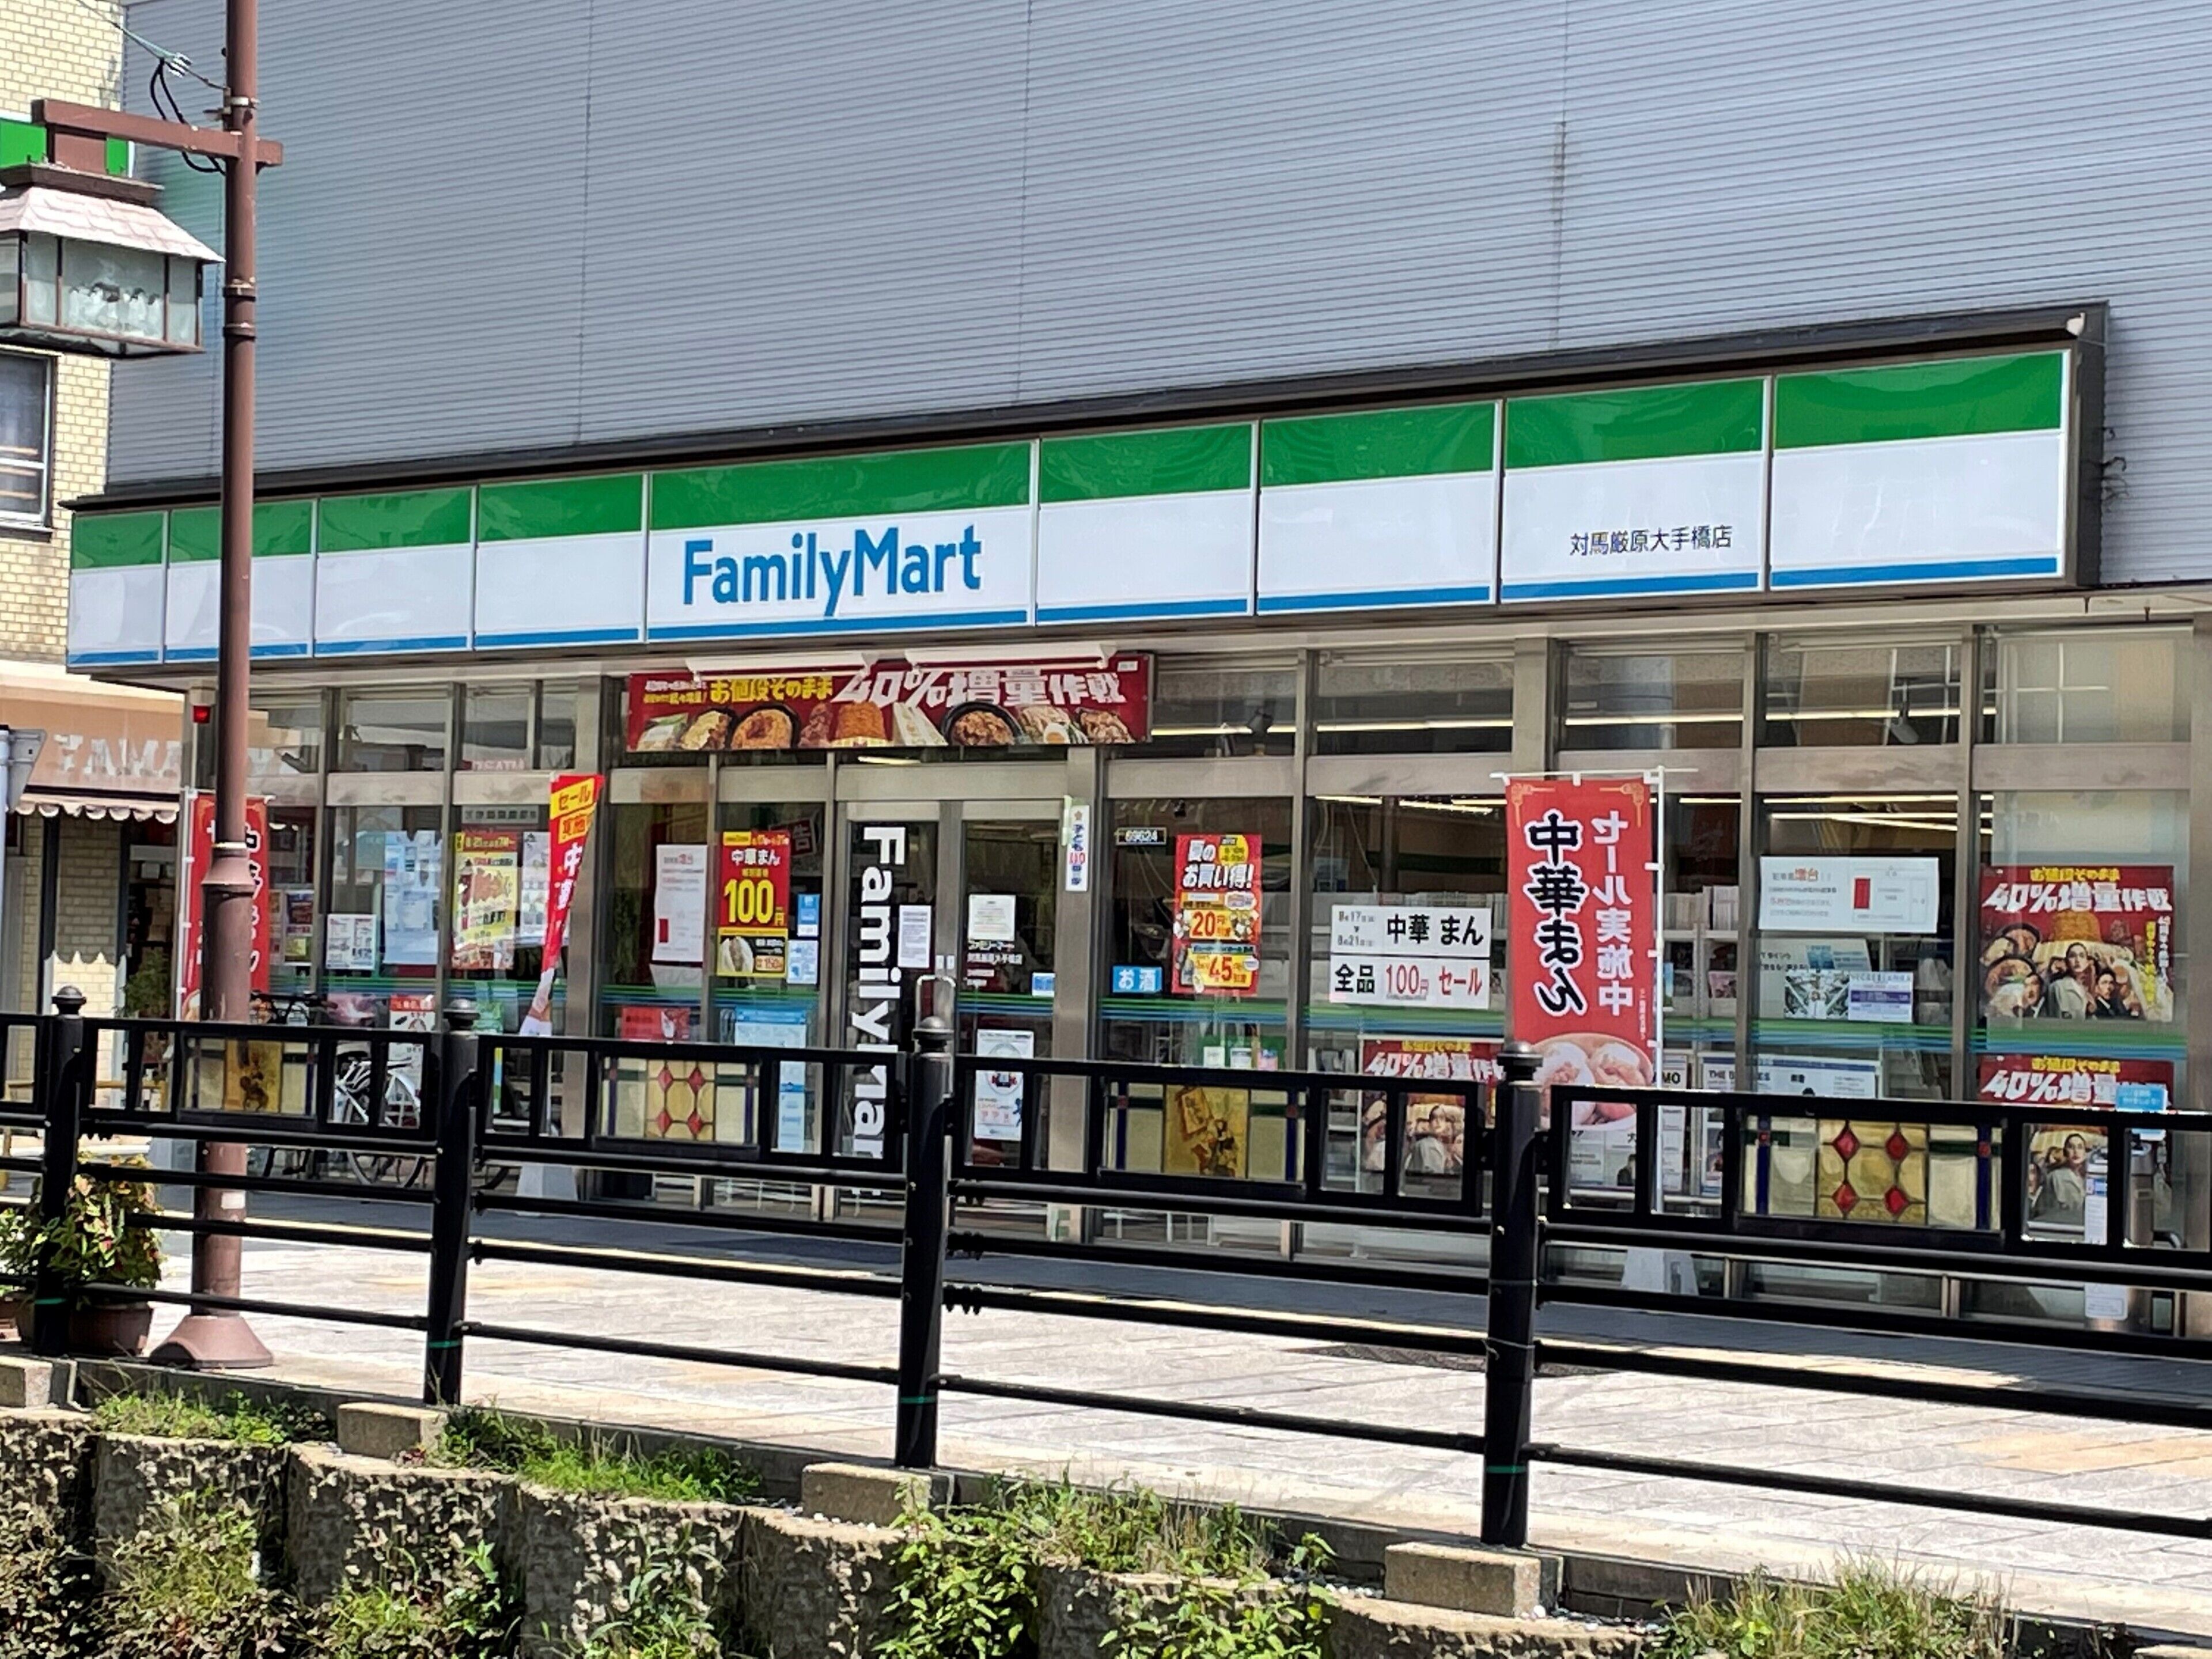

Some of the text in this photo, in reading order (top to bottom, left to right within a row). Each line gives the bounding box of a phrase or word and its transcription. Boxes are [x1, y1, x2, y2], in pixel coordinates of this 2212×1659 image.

[1569, 524, 1733, 556] 対馬厳原大手橋店
[684, 524, 982, 616] FamilyMart
[710, 668, 1127, 709] お値段そのまま 40%増量作戦
[1982, 882, 2173, 912] 40%増量作戦
[1118, 971, 1157, 990] お酒
[1335, 964, 1376, 994] 全品
[1438, 965, 1483, 997] セール
[852, 827, 906, 1175] FamilyMar
